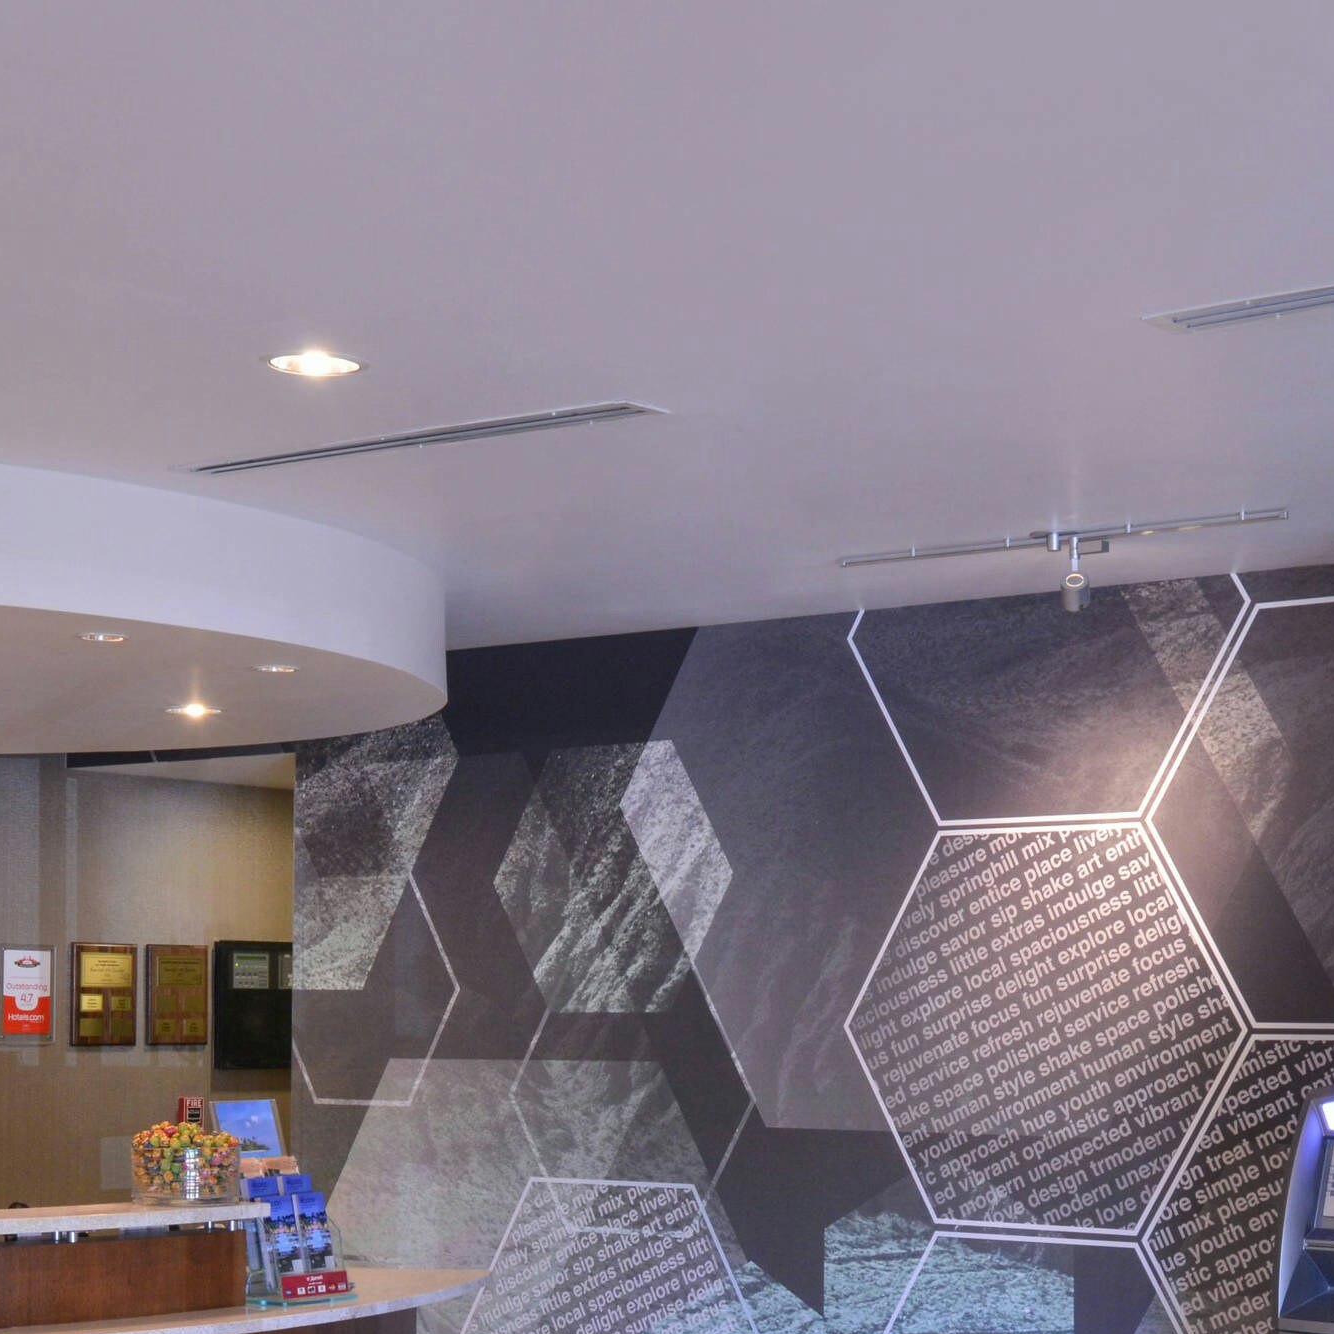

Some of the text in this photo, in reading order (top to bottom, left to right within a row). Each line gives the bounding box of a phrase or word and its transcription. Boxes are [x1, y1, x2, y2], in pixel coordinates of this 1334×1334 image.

[895, 829, 1123, 958] discover entice place lively
[916, 846, 987, 902] pleasure
[939, 830, 1055, 909] springhill mix
[876, 854, 1104, 994] indulge savor sip shake art
[901, 889, 1132, 1027] explore local spaciousness
[949, 874, 1115, 975] little extras indulge
[6, 982, 48, 993] Outstanding
[891, 890, 1175, 1058] fun surprise delight explore local
[8, 1013, 44, 1021] Hotels.com
[882, 943, 1131, 1086] rejuvenate focus fun surprise
[909, 938, 1186, 1096] service refresh rejuvenate focus
[933, 955, 1200, 1108] space polished service refresh
[186, 1099, 203, 1108] FIRE
[919, 1012, 1194, 1168] youth environment human style
[931, 1094, 991, 1134] human
[994, 1069, 1036, 1101] style
[1038, 1040, 1093, 1077] shake
[1095, 1009, 1150, 1050] space
[940, 1015, 1234, 1178] approach hue youth environment
[958, 1150, 1020, 1192] vibrant
[1022, 1107, 1110, 1161] optimistic
[1113, 1060, 1202, 1115] approach
[1226, 1090, 1298, 1136] vibrant
[959, 1084, 1202, 1219] modern unexpected vibrant
[1027, 1124, 1176, 1208] design trmodern
[1194, 1163, 1261, 1204] simple
[1206, 1135, 1254, 1172] treat
[510, 1203, 569, 1245] pleasure
[531, 1206, 596, 1253] springhill
[598, 1193, 625, 1220] mix
[1042, 1182, 1113, 1225] modern
[1096, 1197, 1137, 1223] love
[1179, 1209, 1214, 1240] mix
[495, 1188, 679, 1295] discover entice place lively
[532, 1230, 639, 1297] savor sip shake
[573, 1235, 673, 1297] extras indulge
[1187, 1221, 1245, 1264] youth
[551, 1302, 586, 1332] local
[588, 1252, 686, 1312] spaciousness
[627, 1278, 681, 1313] explore
[681, 1255, 719, 1285] local
[1207, 1260, 1275, 1303] vibrant
